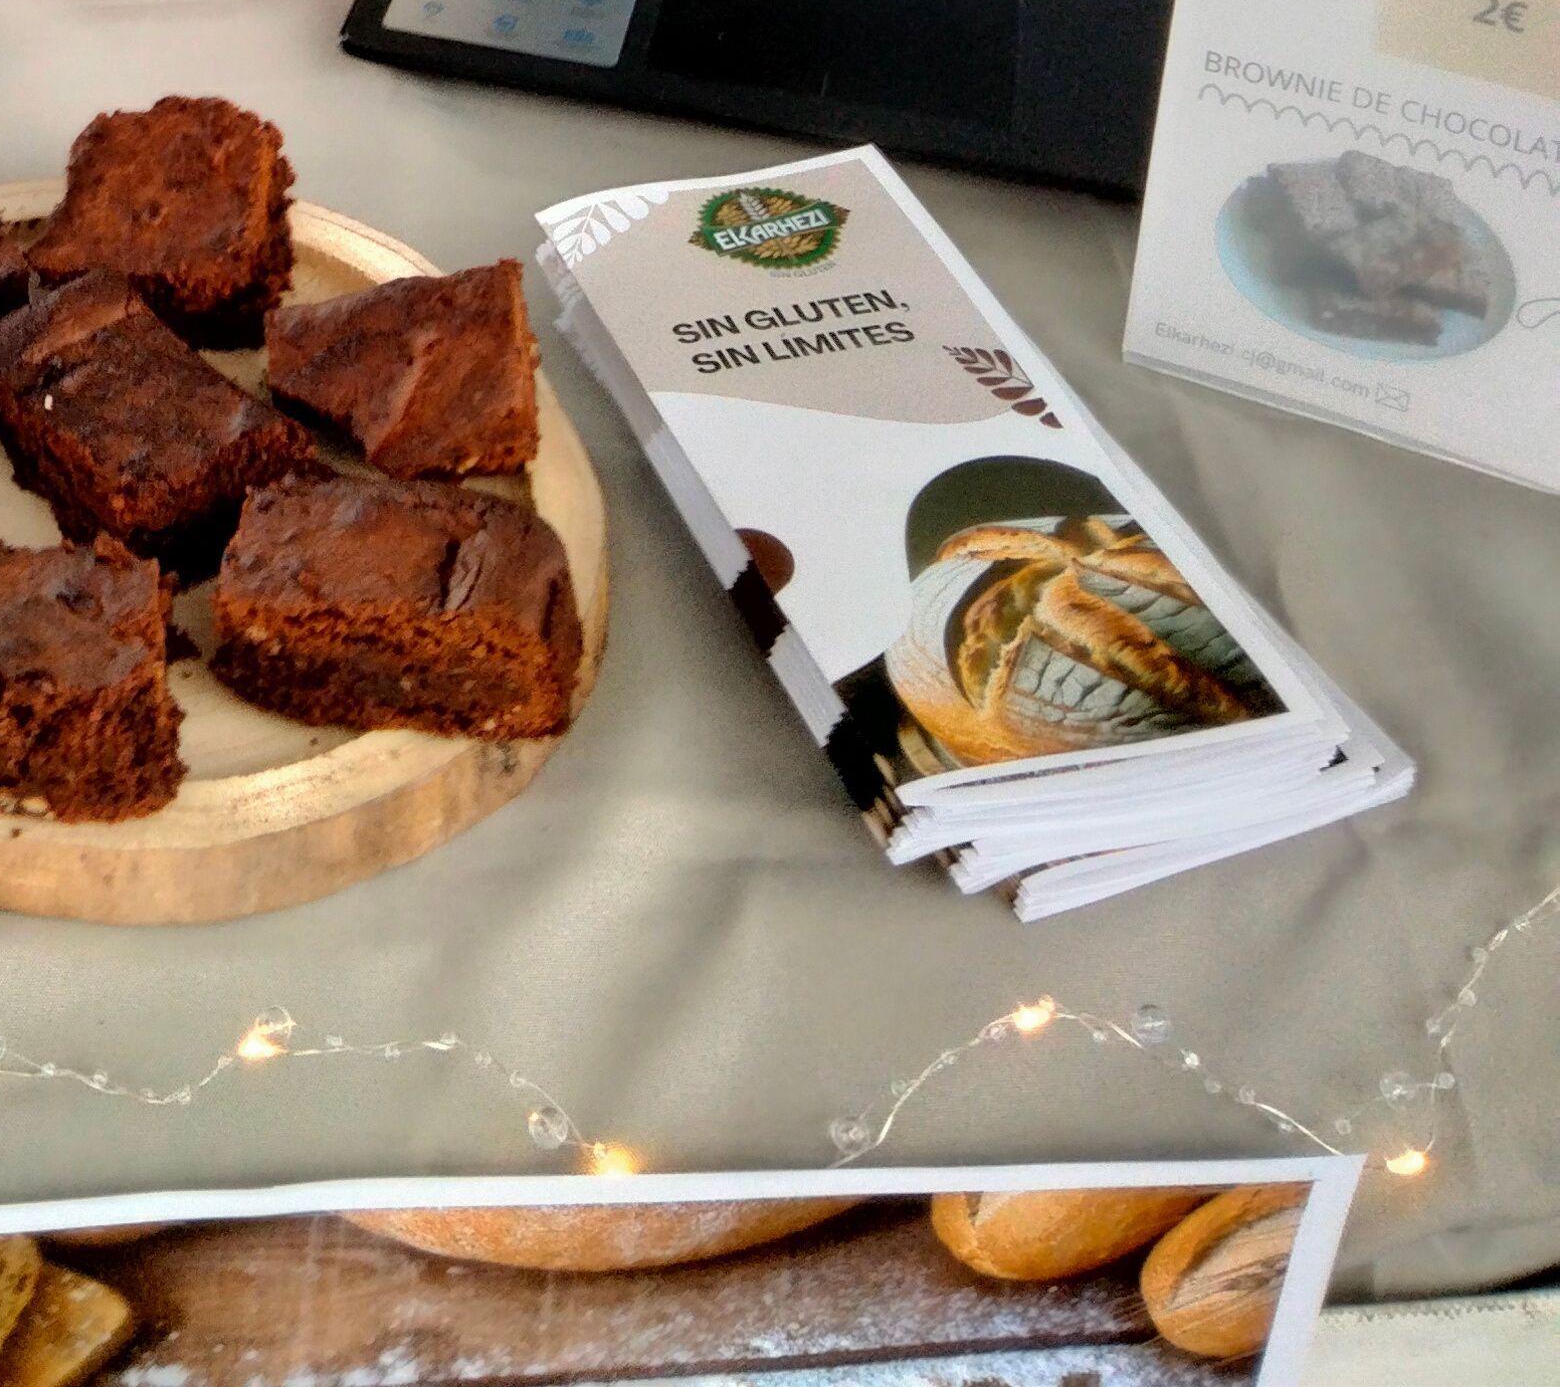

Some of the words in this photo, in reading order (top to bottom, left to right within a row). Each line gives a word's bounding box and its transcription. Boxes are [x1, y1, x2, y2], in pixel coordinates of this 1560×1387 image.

[1204, 50, 1344, 104] BROWNIE
[1352, 87, 1392, 115] DE
[672, 315, 740, 344] SIN
[744, 289, 911, 330] GLUTEN,
[692, 344, 761, 374] SIN
